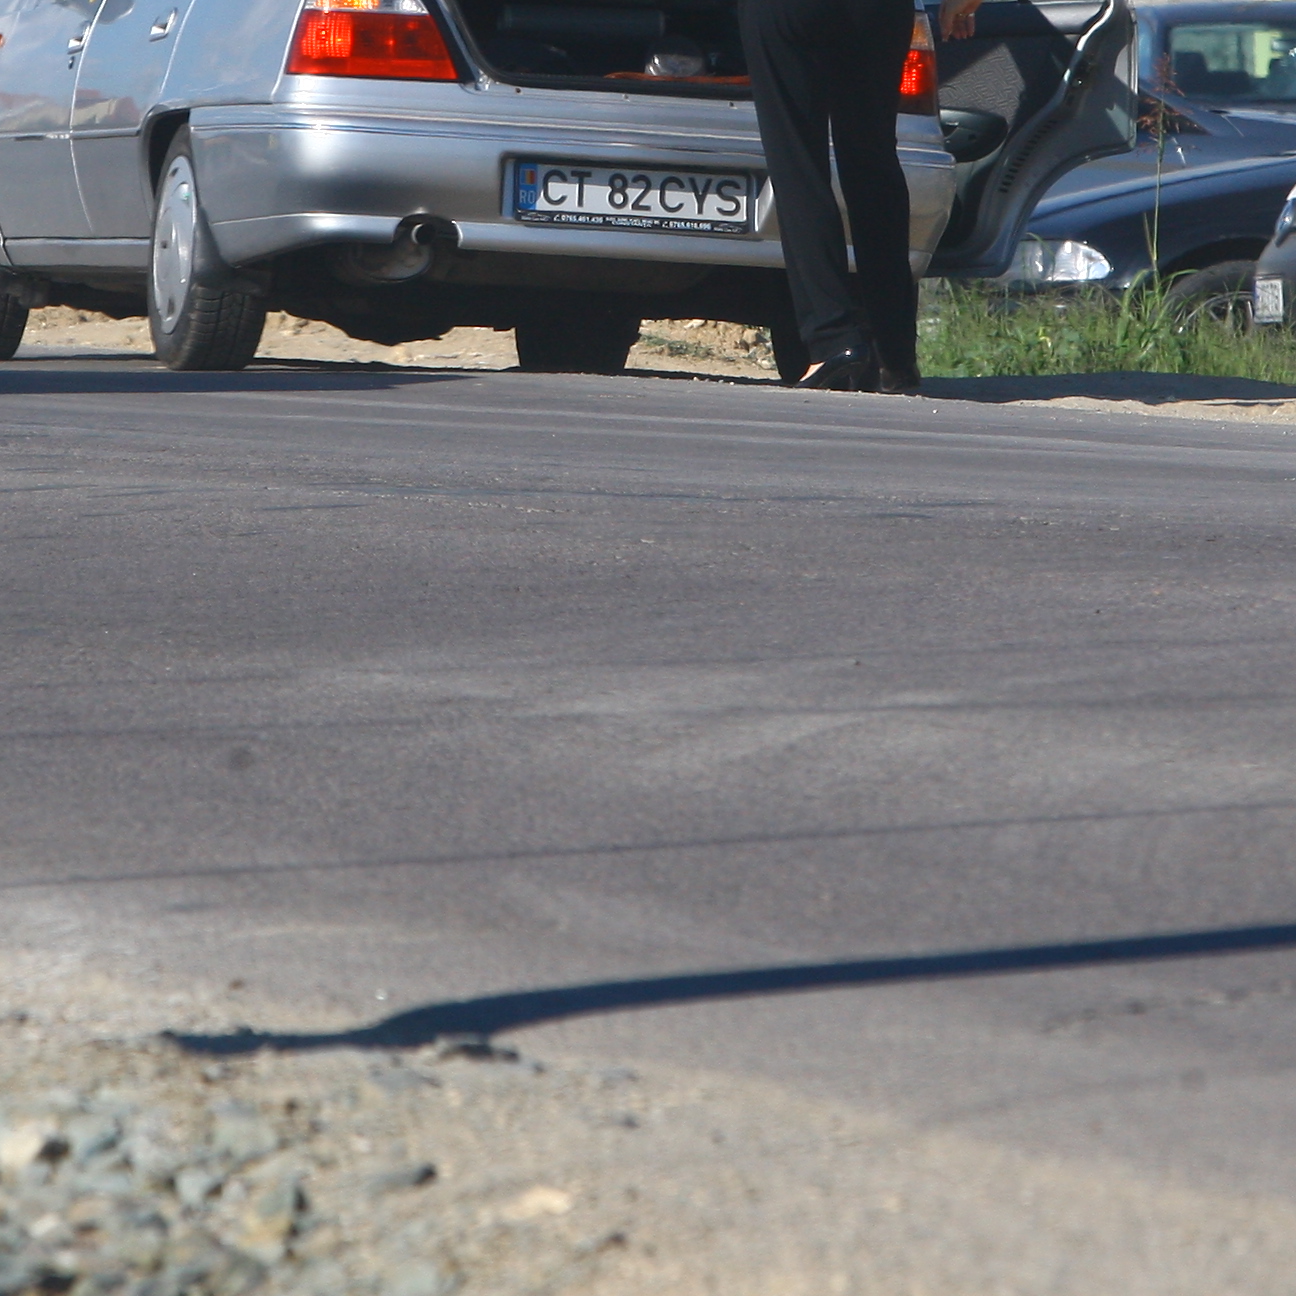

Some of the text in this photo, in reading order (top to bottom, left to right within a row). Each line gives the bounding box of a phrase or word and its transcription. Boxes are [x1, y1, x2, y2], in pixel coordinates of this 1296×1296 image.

[542, 169, 742, 217] CT 82 CYS
